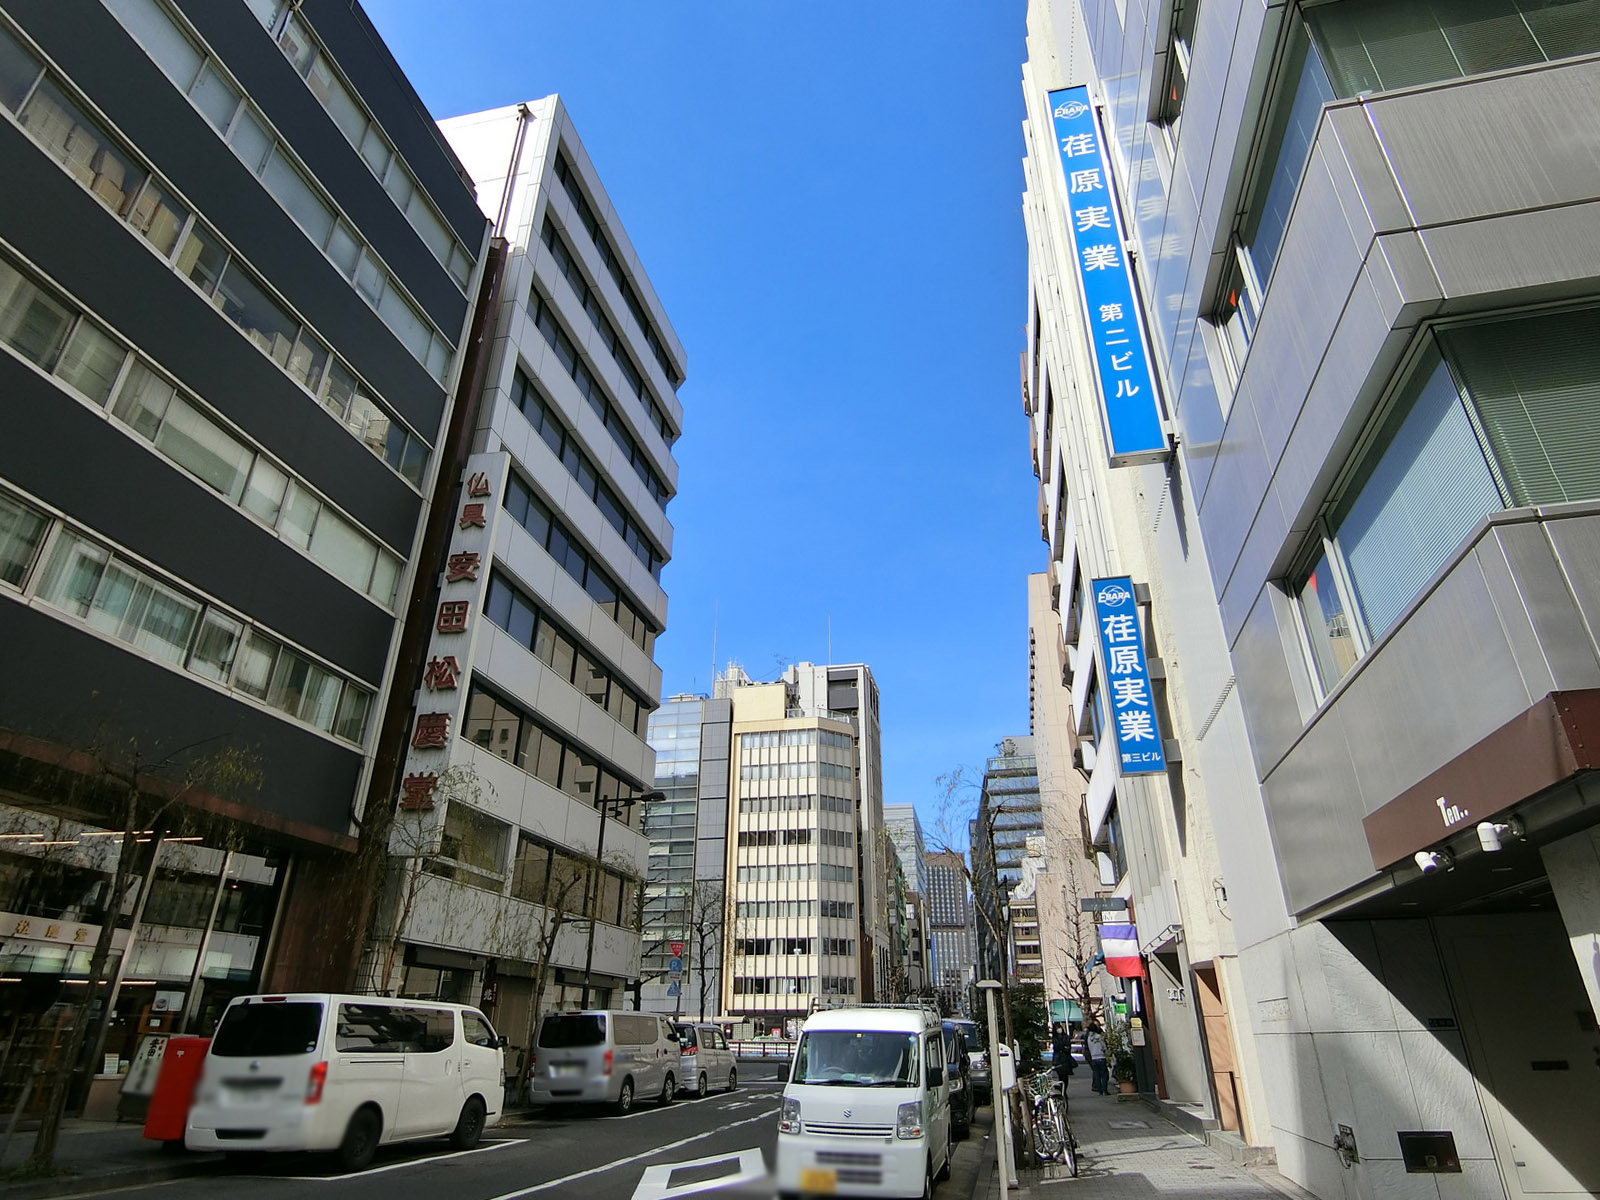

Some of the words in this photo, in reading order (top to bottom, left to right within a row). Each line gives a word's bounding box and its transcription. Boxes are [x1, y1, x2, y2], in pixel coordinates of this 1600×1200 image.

[1054, 104, 1089, 118] EBARA
[1061, 133, 1120, 271] 荏原実業
[1099, 303, 1140, 399] 第二ビル
[459, 471, 491, 530] 仏具
[1098, 591, 1131, 604] EBARA
[399, 551, 481, 812] 安田松慶堂
[1102, 614, 1155, 742] 荏原実業
[1121, 751, 1161, 763] 第三ビル
